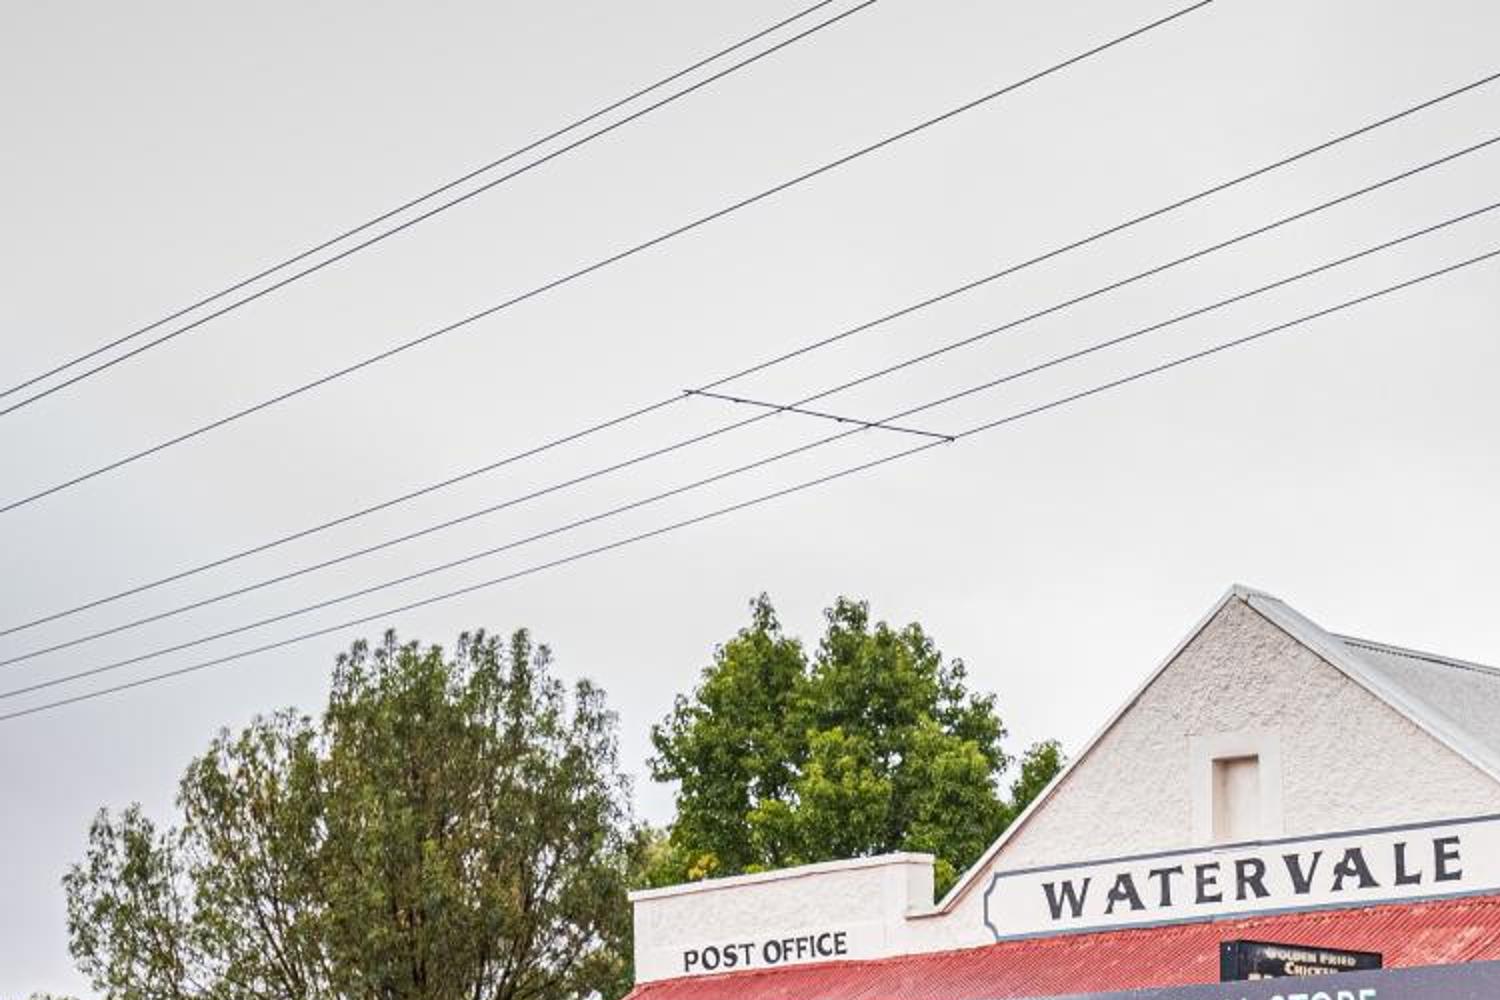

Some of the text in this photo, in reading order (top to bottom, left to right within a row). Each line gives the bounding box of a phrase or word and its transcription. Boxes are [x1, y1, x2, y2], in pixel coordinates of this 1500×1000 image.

[1042, 836, 1463, 920] WATERVALE
[684, 931, 847, 972] POST OFFICE
